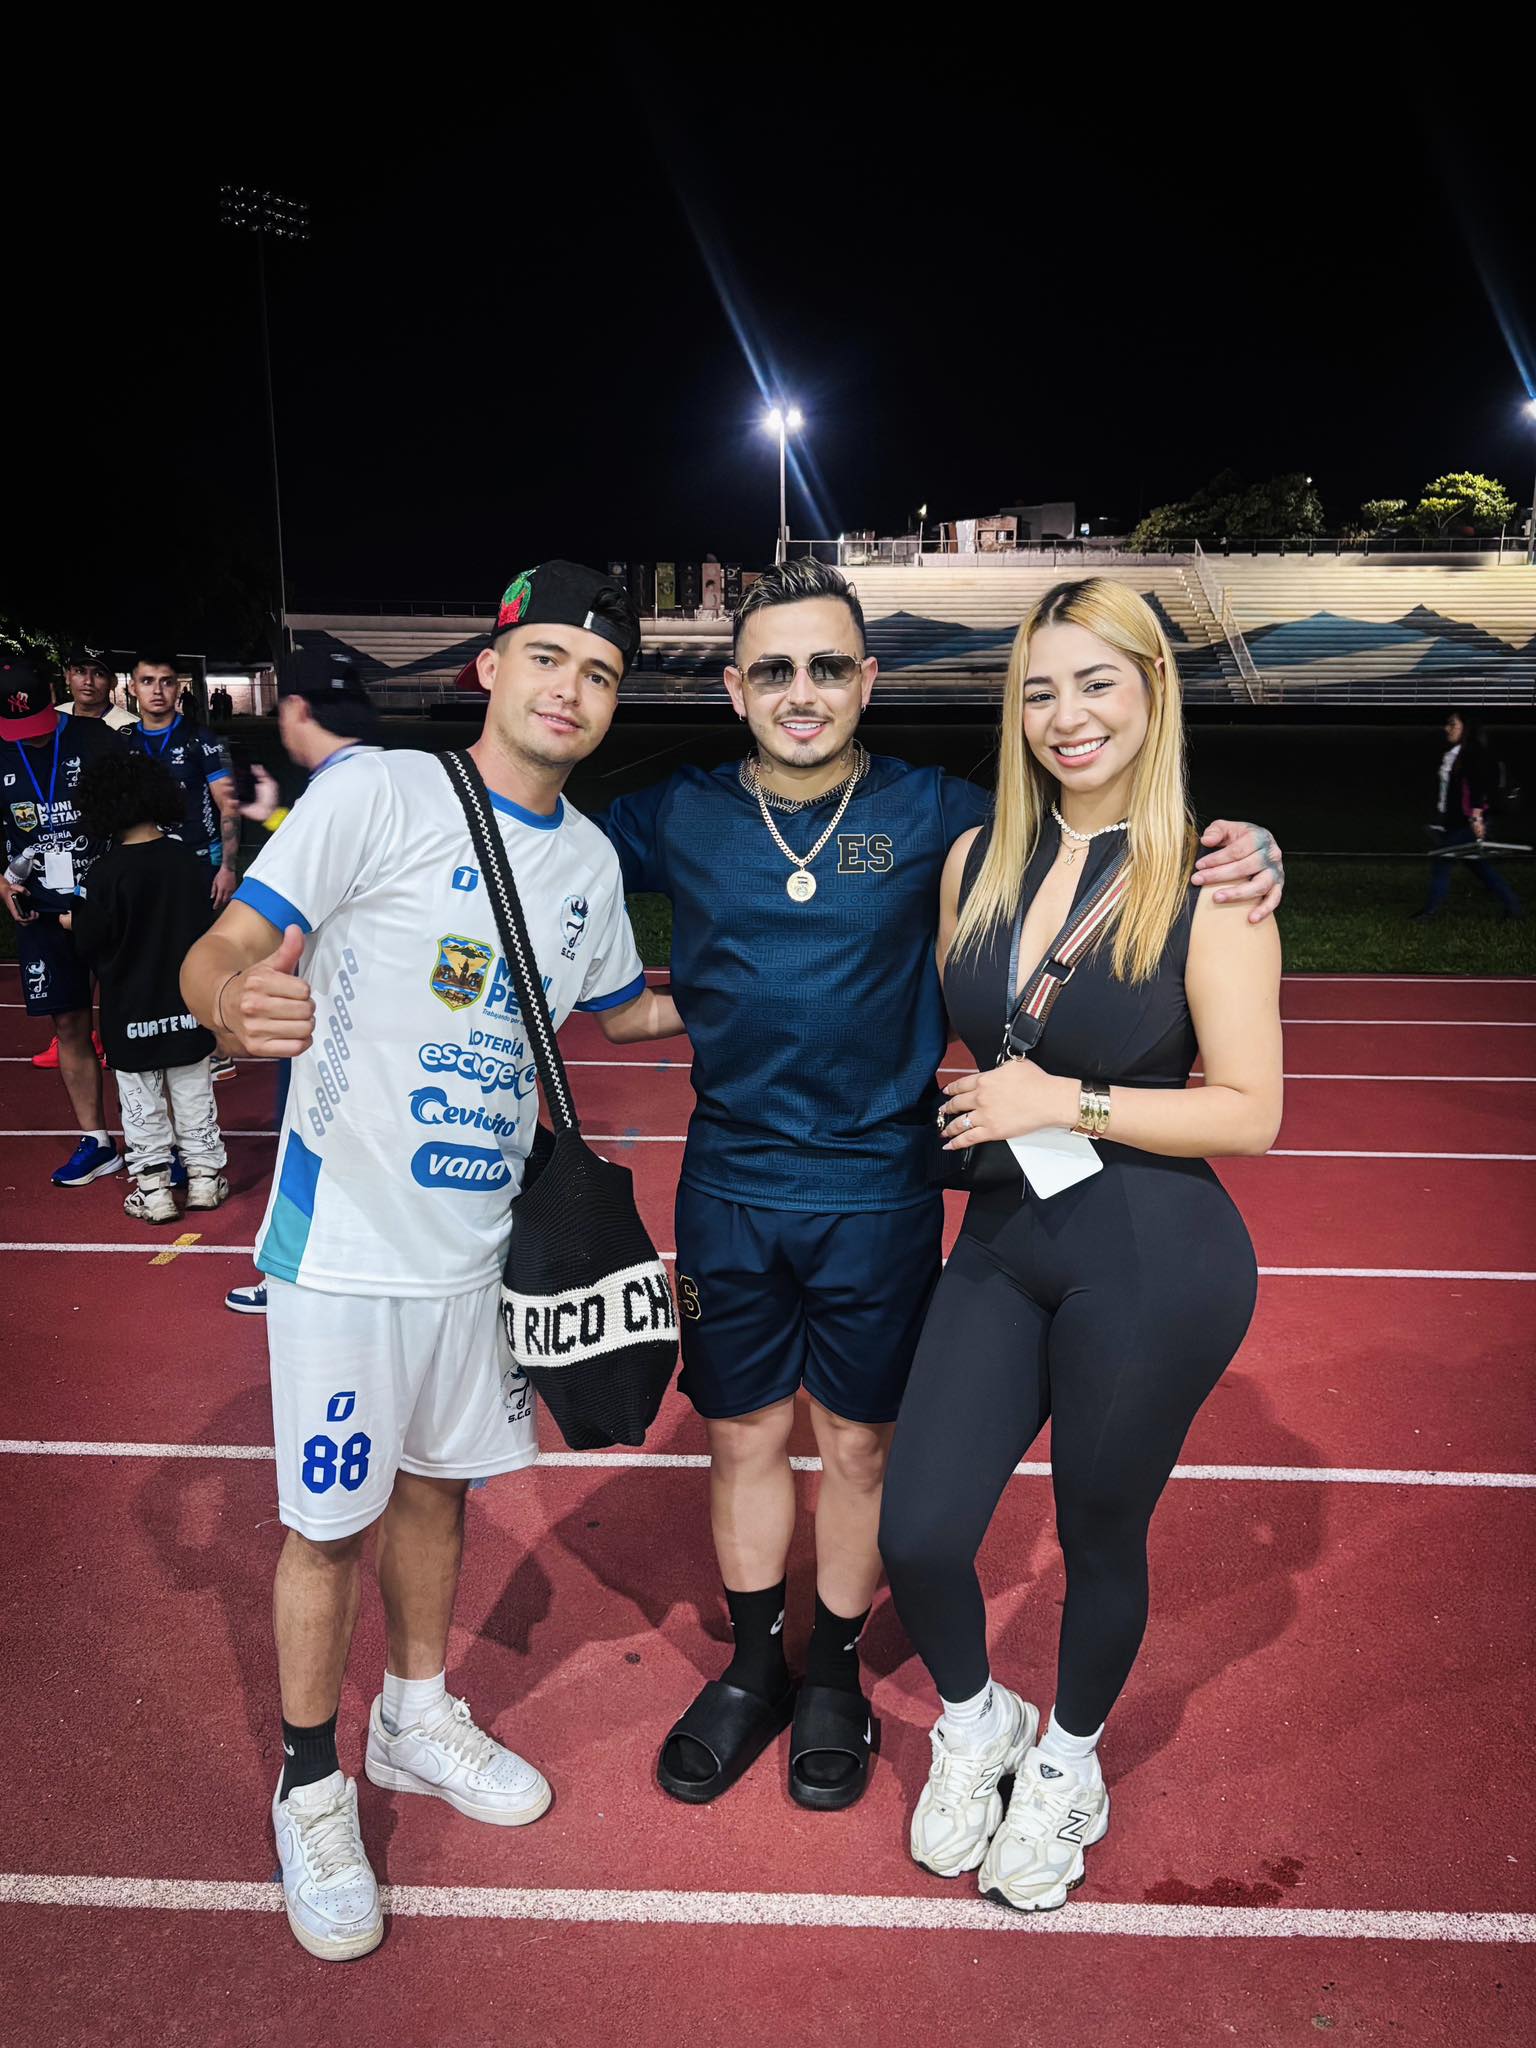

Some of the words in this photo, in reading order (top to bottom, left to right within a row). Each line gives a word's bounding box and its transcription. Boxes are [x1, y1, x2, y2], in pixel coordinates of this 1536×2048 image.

[37, 801, 72, 814] MUNI
[837, 833, 894, 874] ES
[469, 1027, 524, 1059] LOTERÍA
[525, 1294, 605, 1355] RICO
[508, 1407, 531, 1424] S.C.G
[302, 1432, 371, 1494] 88
[1057, 1809, 1091, 1844] N
